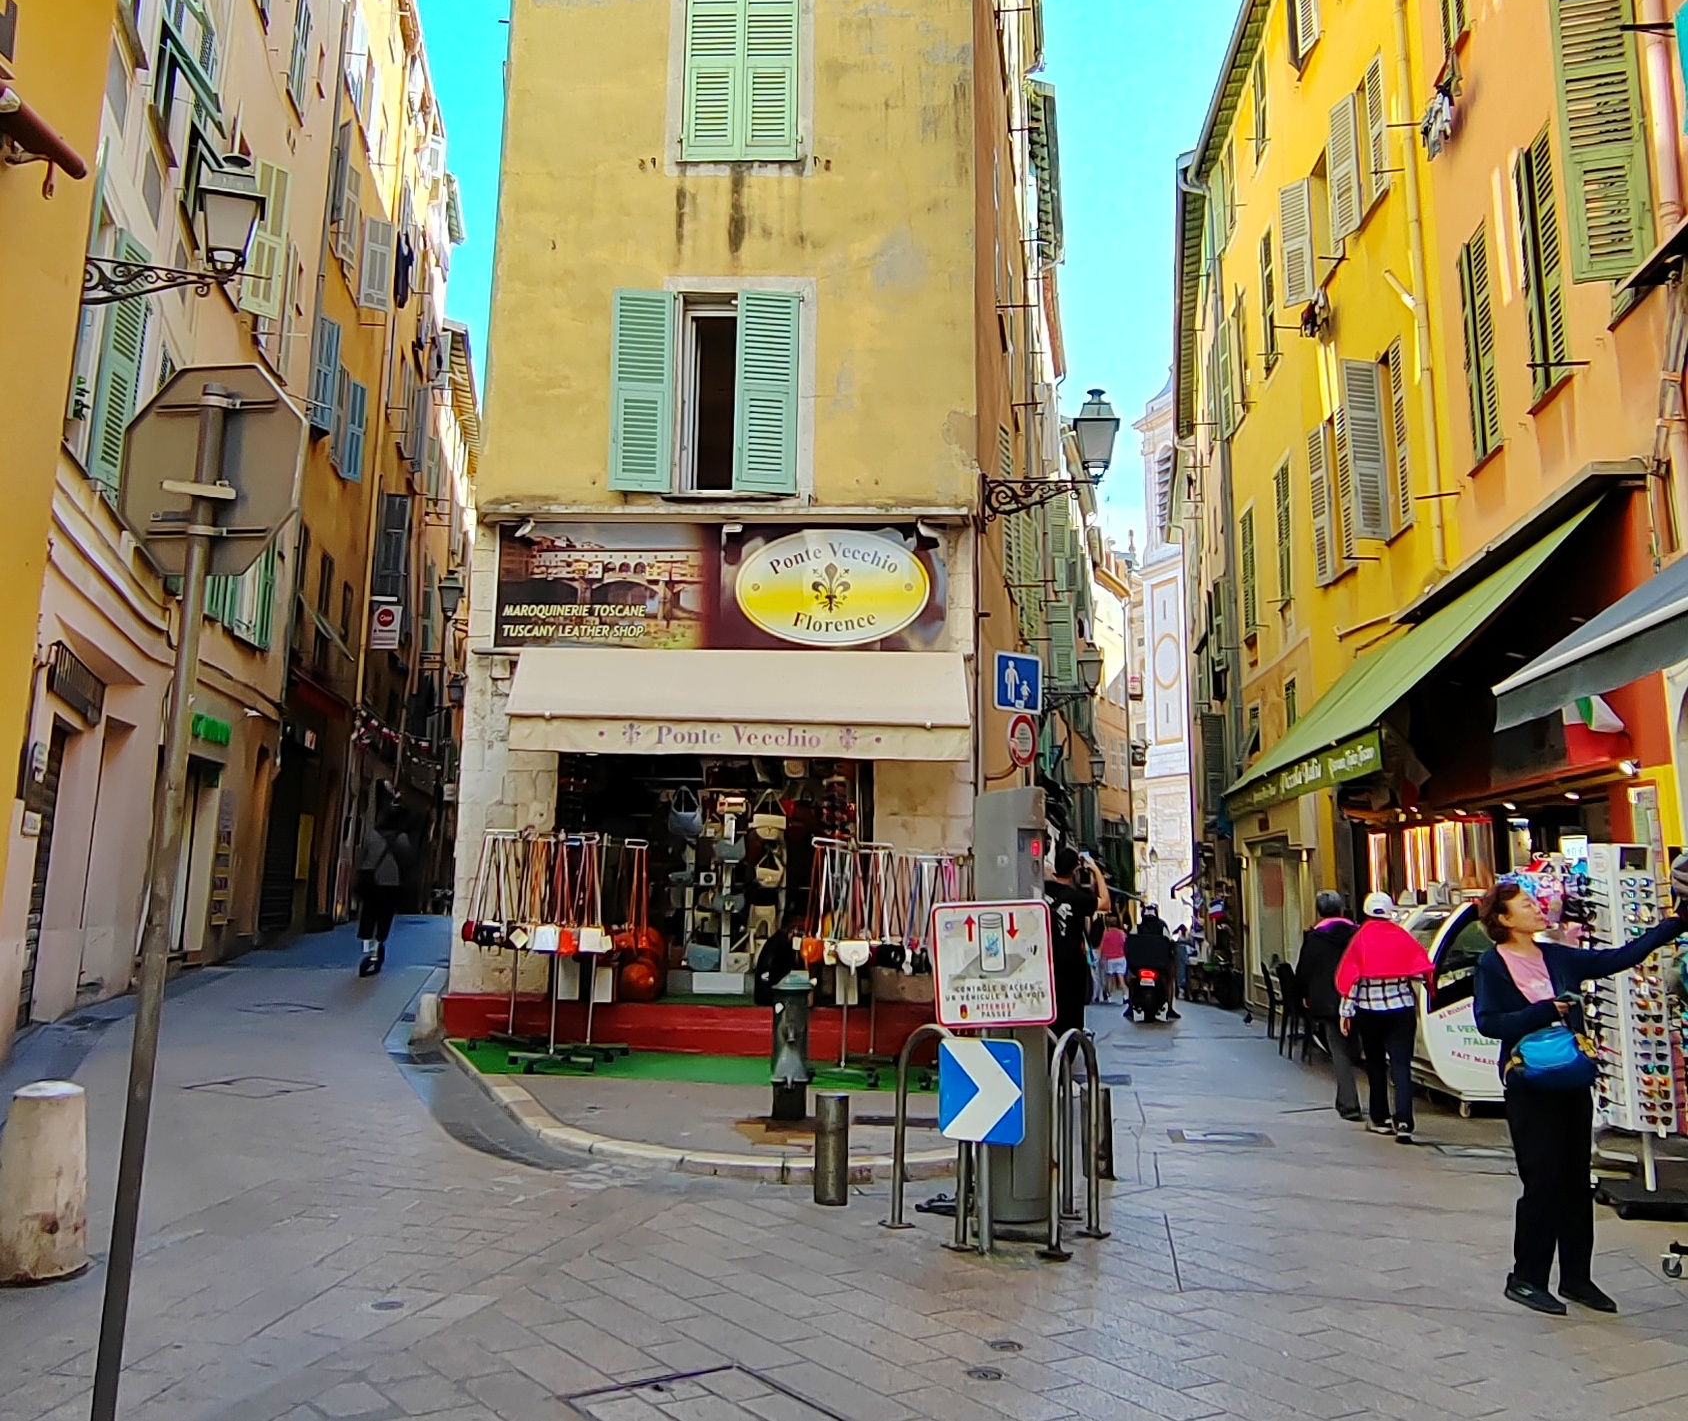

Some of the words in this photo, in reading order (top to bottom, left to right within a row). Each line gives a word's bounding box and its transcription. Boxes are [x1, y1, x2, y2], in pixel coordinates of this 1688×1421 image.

[769, 546, 822, 575] Ponte
[828, 541, 899, 574] Vecchio
[502, 604, 590, 618] MAROQUINERIE
[593, 604, 646, 617] TOSCANE
[792, 611, 876, 633] Florence
[502, 625, 556, 637] TUSCANY
[558, 625, 609, 637] LEATHER
[613, 625, 644, 637] SHOP
[656, 725, 721, 745] Ponte
[732, 724, 821, 748] Vecchio
[955, 984, 997, 993] CONTRÔLE
[960, 992, 999, 1001] VÉHICULE
[976, 1002, 1016, 1010] ATTENDEZ
[981, 1010, 1012, 1018] PASSEZ
